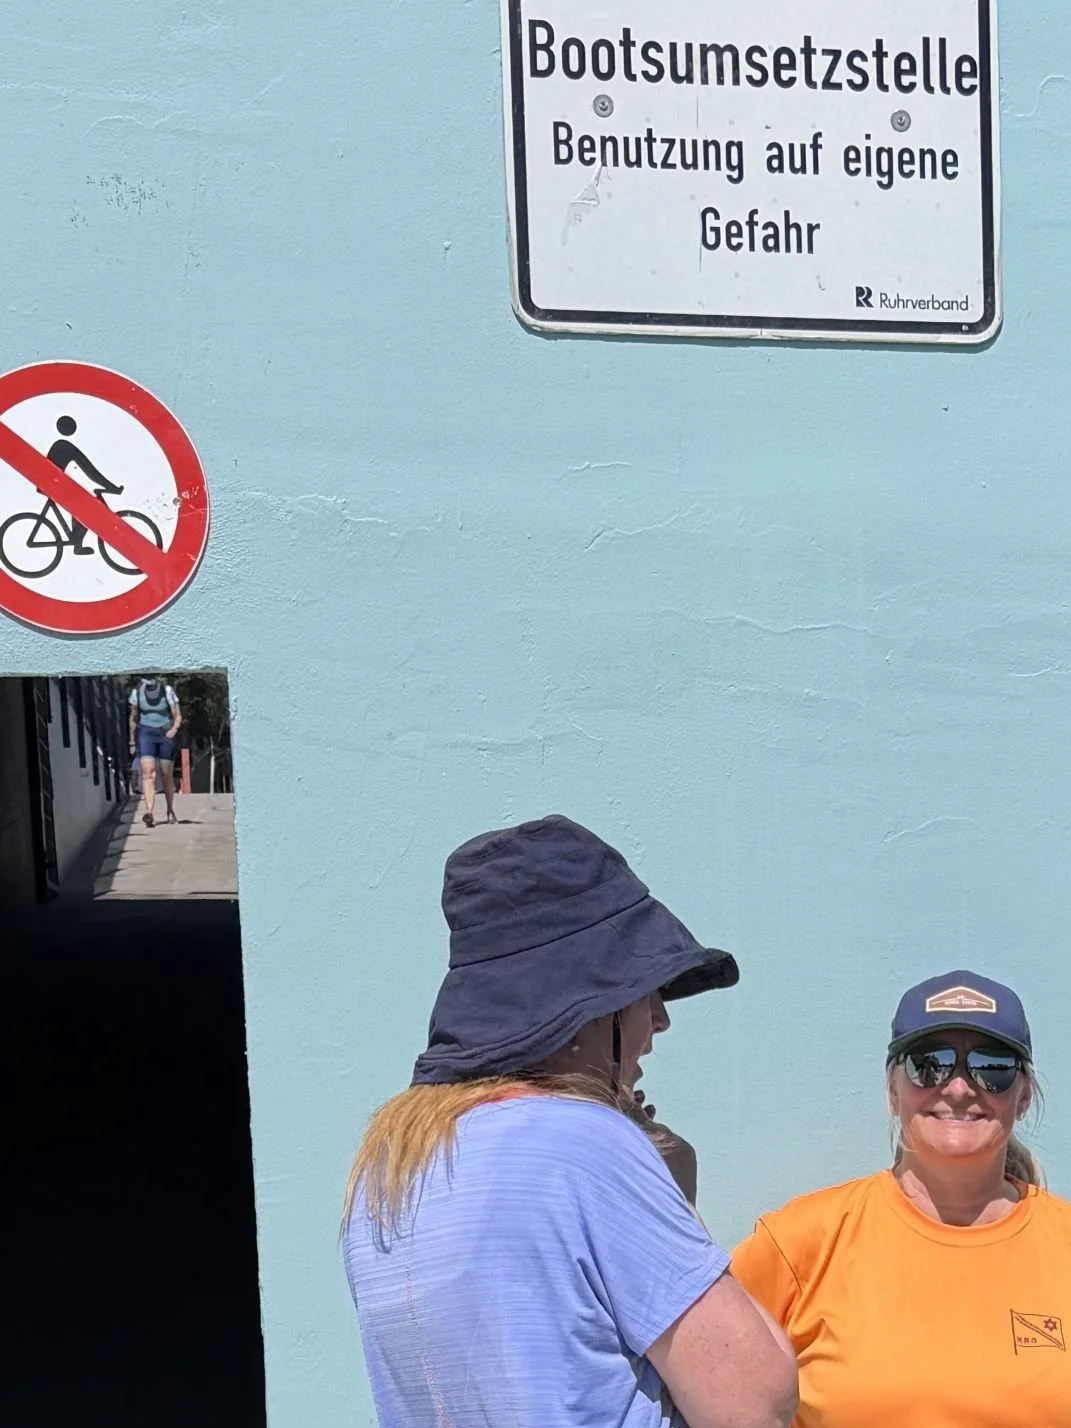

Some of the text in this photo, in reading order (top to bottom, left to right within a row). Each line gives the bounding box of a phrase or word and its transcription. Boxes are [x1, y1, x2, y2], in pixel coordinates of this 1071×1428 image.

[528, 19, 979, 96] Bootsumsetzstelle
[552, 121, 959, 190] Benutzung auf eigene
[700, 206, 821, 254] Gefahr
[880, 292, 969, 311] Ruhrverband
